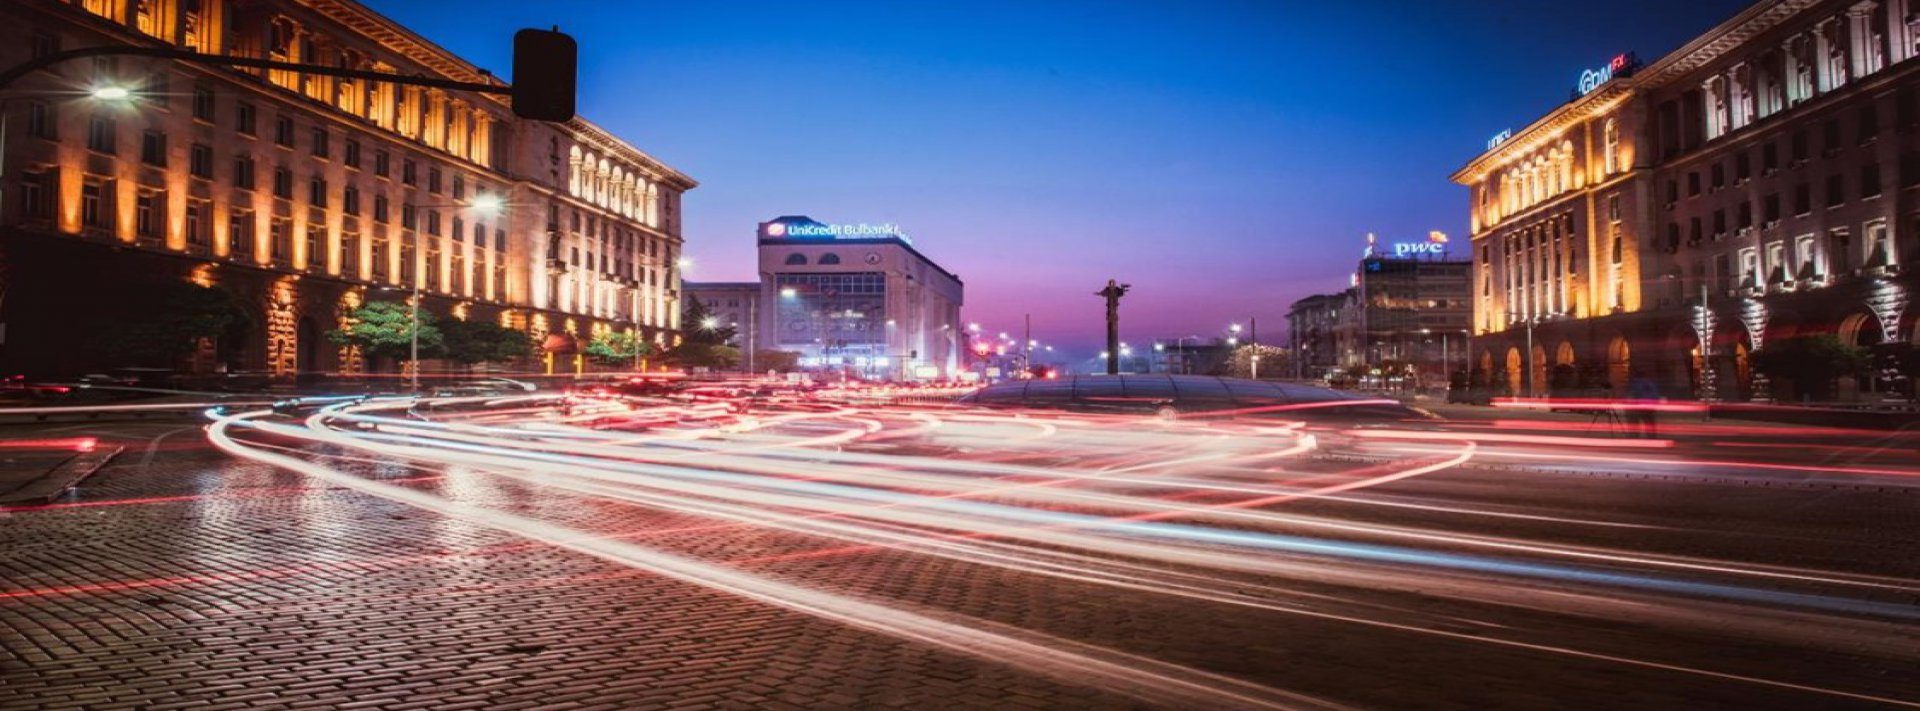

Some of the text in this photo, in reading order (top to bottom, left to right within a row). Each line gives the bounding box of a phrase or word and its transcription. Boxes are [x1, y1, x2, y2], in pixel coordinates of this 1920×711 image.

[788, 223, 842, 236] UniCredit
[844, 223, 895, 235] Bulbank
[1394, 242, 1442, 256] pwc
